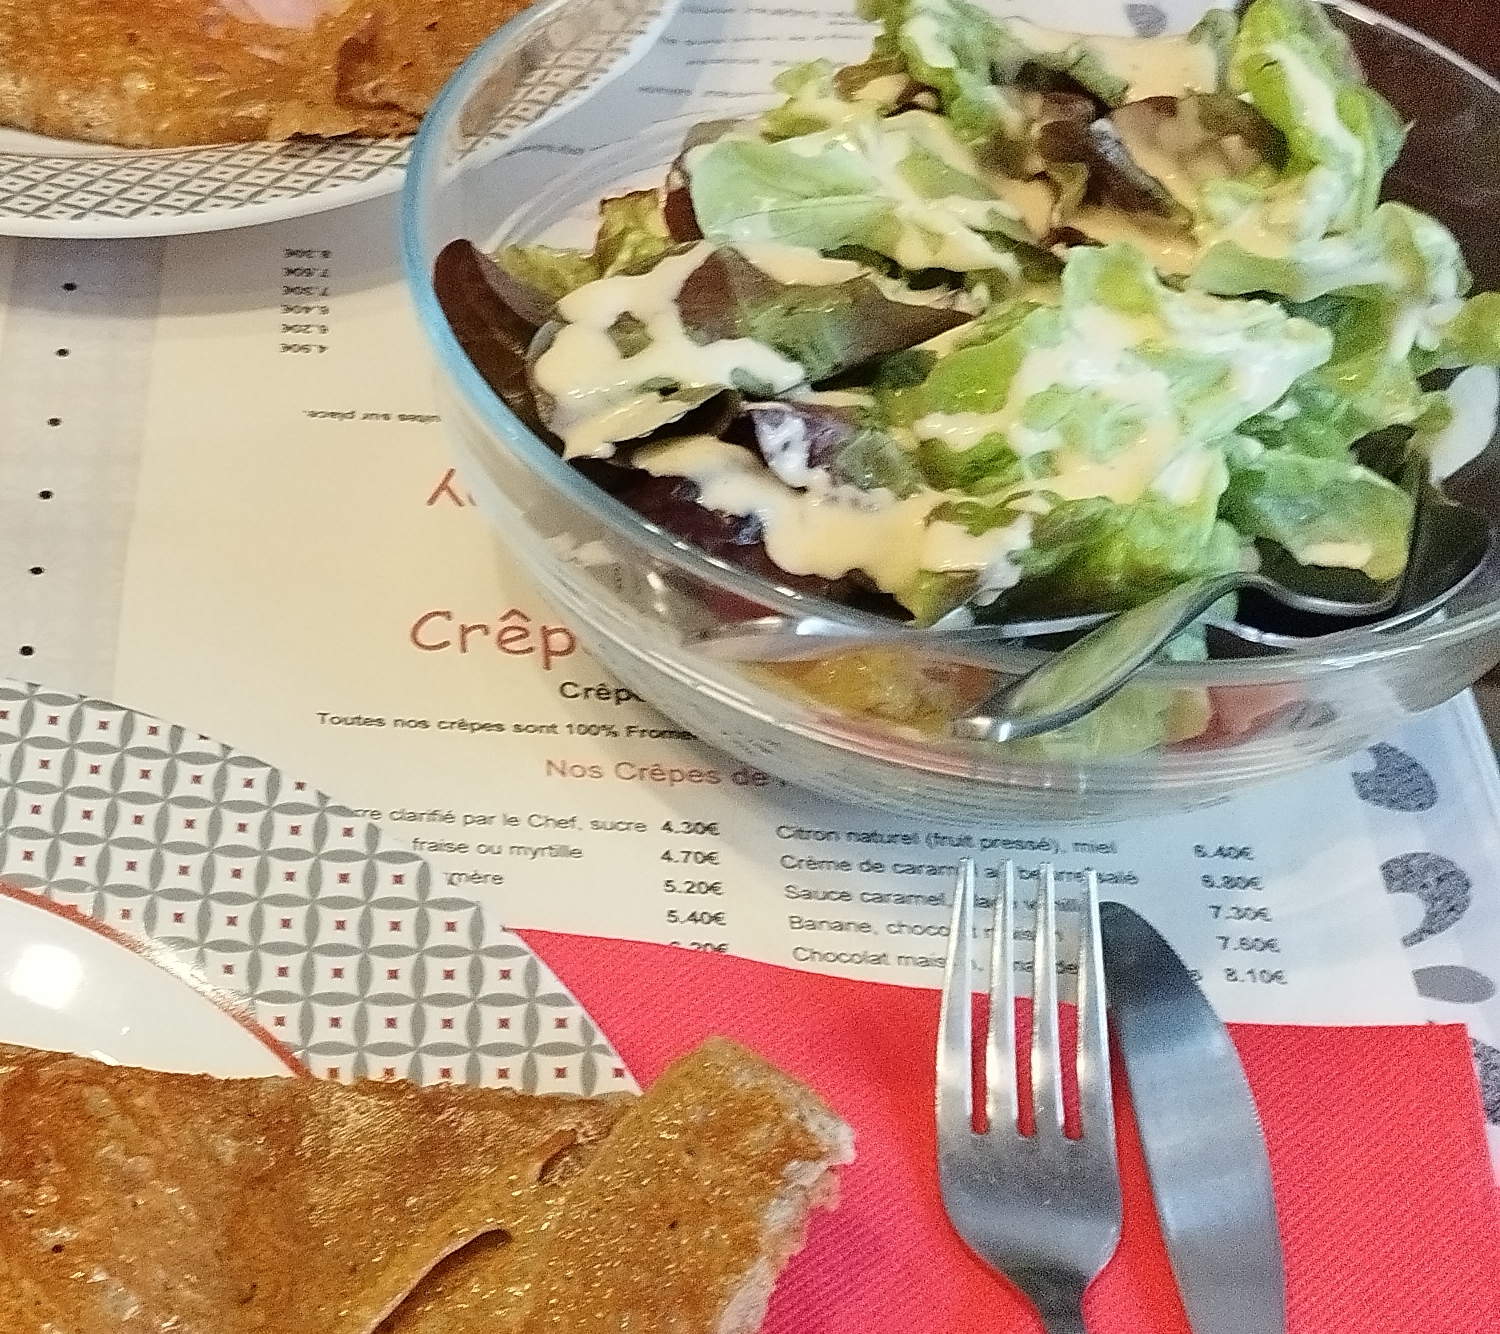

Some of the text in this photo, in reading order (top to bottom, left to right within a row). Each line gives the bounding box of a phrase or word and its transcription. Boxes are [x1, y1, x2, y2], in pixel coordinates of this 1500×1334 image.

[408, 606, 578, 671] Crêp
[558, 680, 646, 704] Crêp
[315, 710, 621, 739] Toutes nos crêpes sont 100%
[544, 758, 771, 787] Nos Crêpes de
[388, 804, 457, 826] clarifié
[461, 812, 498, 830] par
[502, 810, 522, 827] le
[527, 811, 584, 833] Chef,
[590, 818, 648, 834] sucre
[660, 819, 723, 838] 4.30€
[411, 835, 723, 867] fraise ou myrtille 4.70€
[775, 823, 842, 844] Citron
[846, 825, 922, 847] naturel
[925, 830, 975, 851] (fruit
[979, 833, 1068, 857] pressé),
[1072, 837, 1120, 855] miel
[779, 852, 856, 873] Crème
[858, 855, 887, 874] de
[453, 869, 725, 898] mère 5.20€
[784, 883, 854, 904] Sauce
[858, 886, 954, 910] caramel,
[1209, 902, 1275, 924] 7.30€
[665, 909, 728, 928] 5.40€
[787, 914, 880, 937] Banane,
[792, 944, 1290, 986] Chocolat 8.10€
